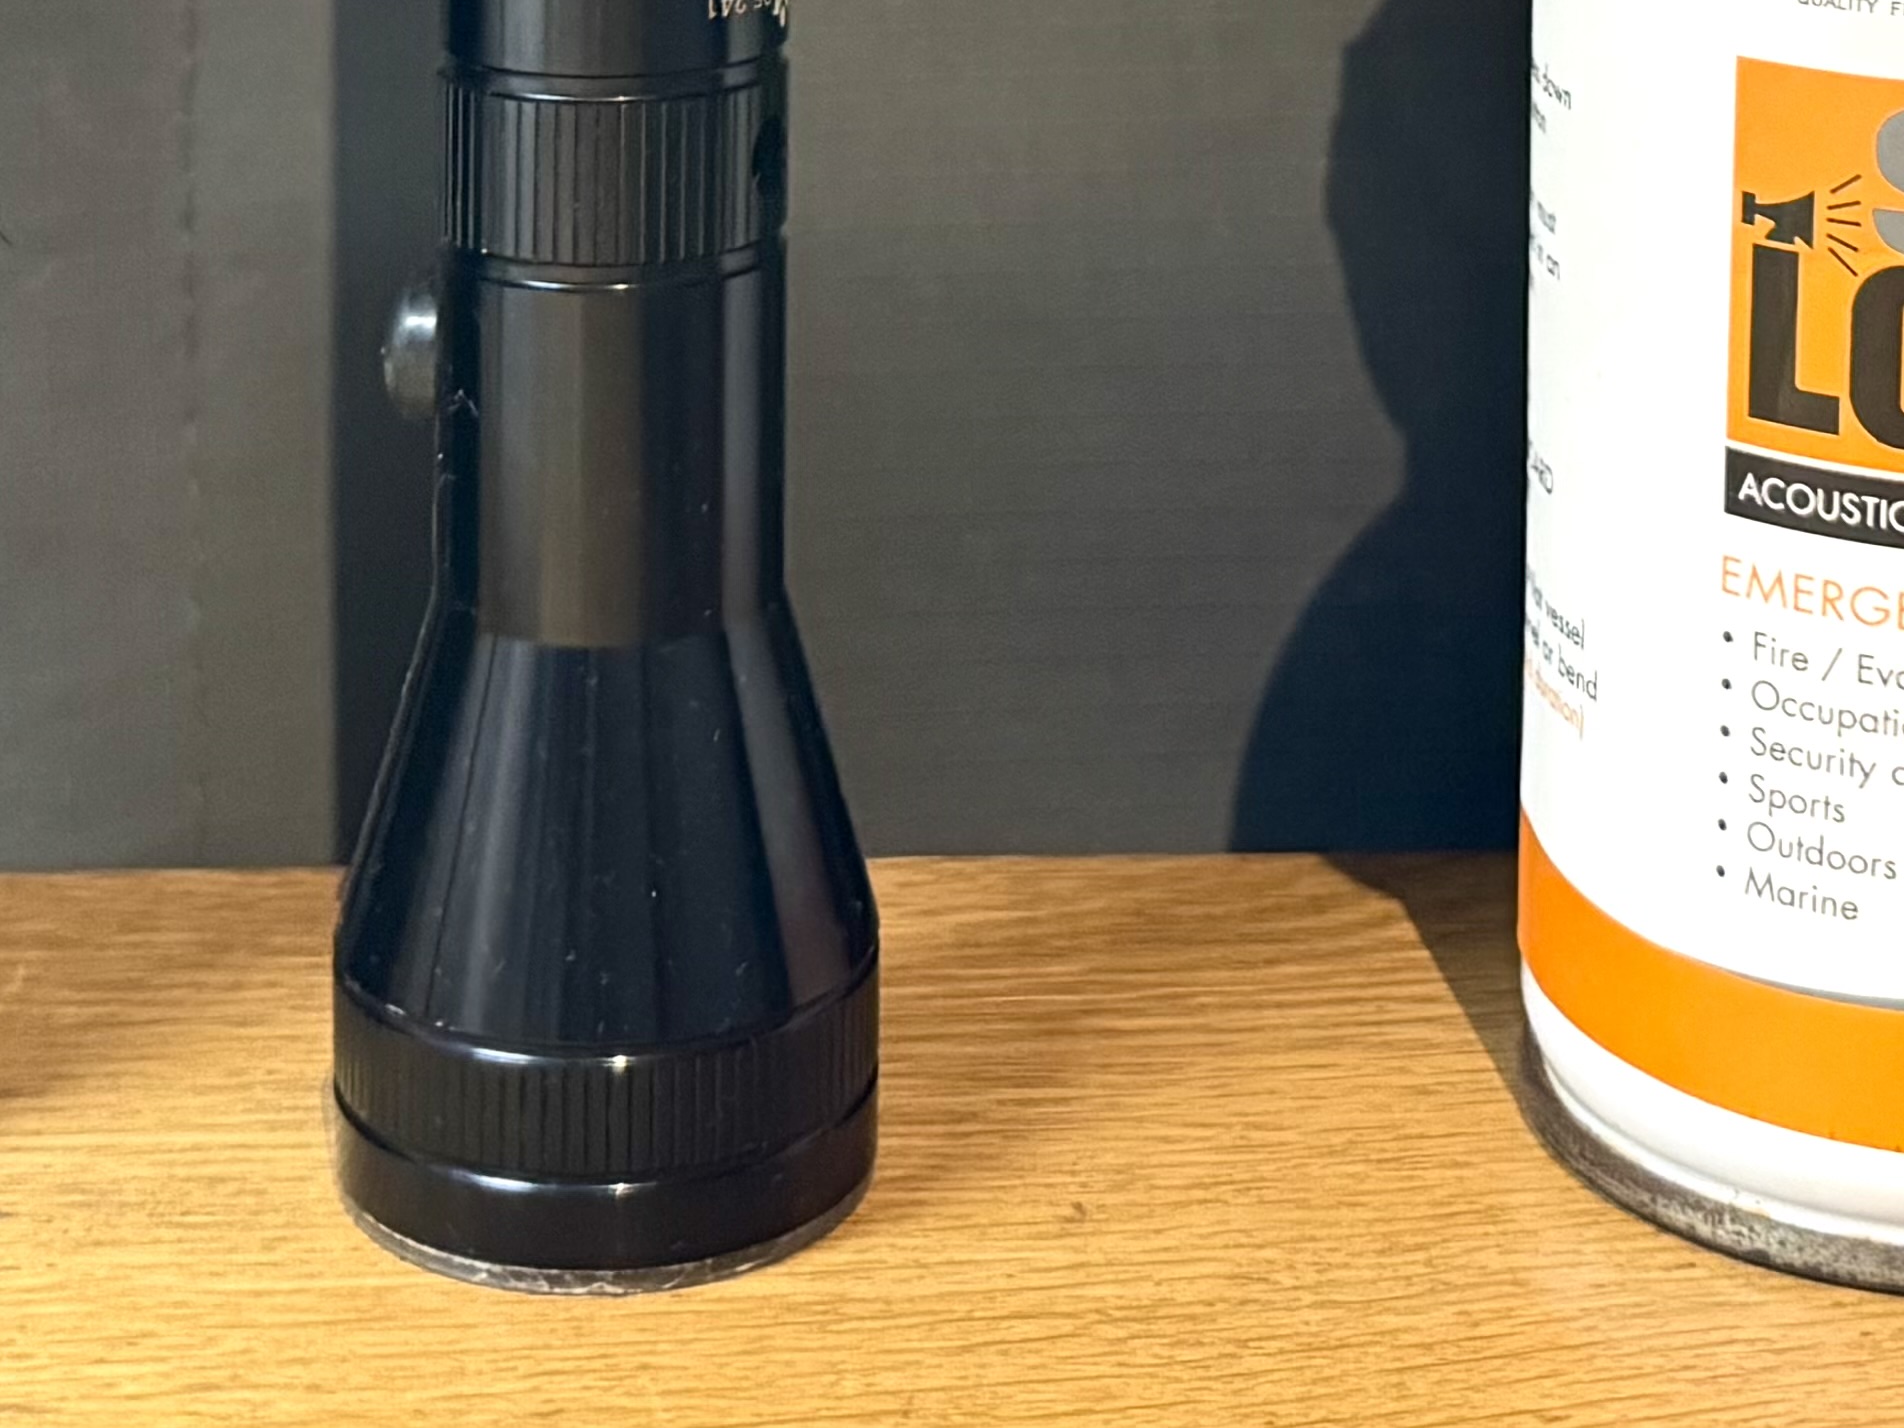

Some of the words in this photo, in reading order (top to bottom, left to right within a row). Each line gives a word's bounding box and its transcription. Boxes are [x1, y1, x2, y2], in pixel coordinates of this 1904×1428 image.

[1753, 630, 1809, 671] Fire
[1821, 647, 1843, 681] /
[1749, 727, 1876, 789] Security
[1748, 773, 1846, 823] Sports
[1746, 821, 1898, 880] Outdoors
[1744, 866, 1859, 921] Marine
